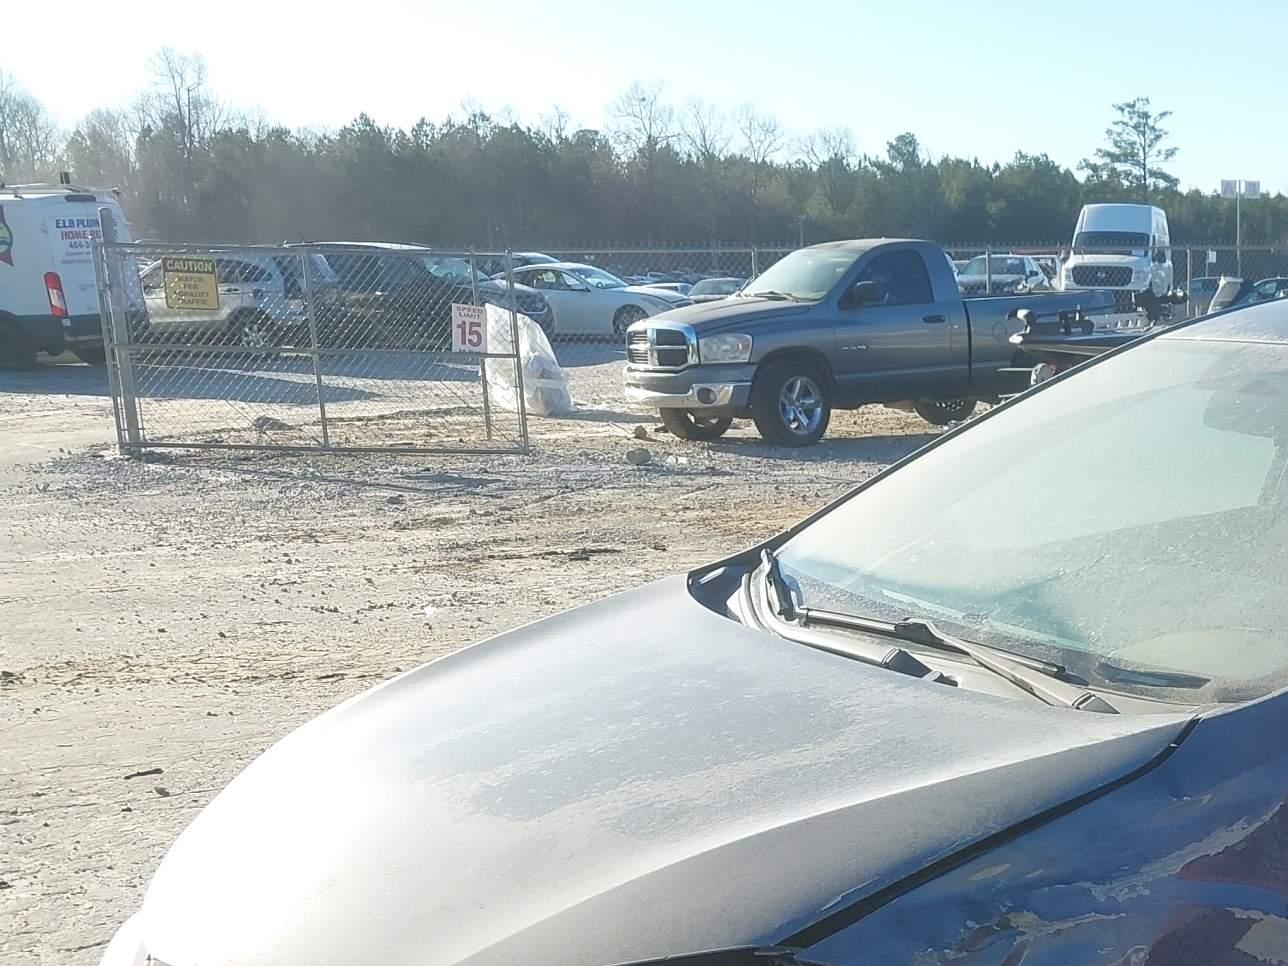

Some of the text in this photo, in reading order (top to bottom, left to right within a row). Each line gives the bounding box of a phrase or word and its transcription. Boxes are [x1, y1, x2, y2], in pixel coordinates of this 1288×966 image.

[61, 230, 88, 241] HOME
[166, 260, 213, 272] CAUTION
[457, 306, 483, 314] SPEED
[456, 320, 483, 347] 15
